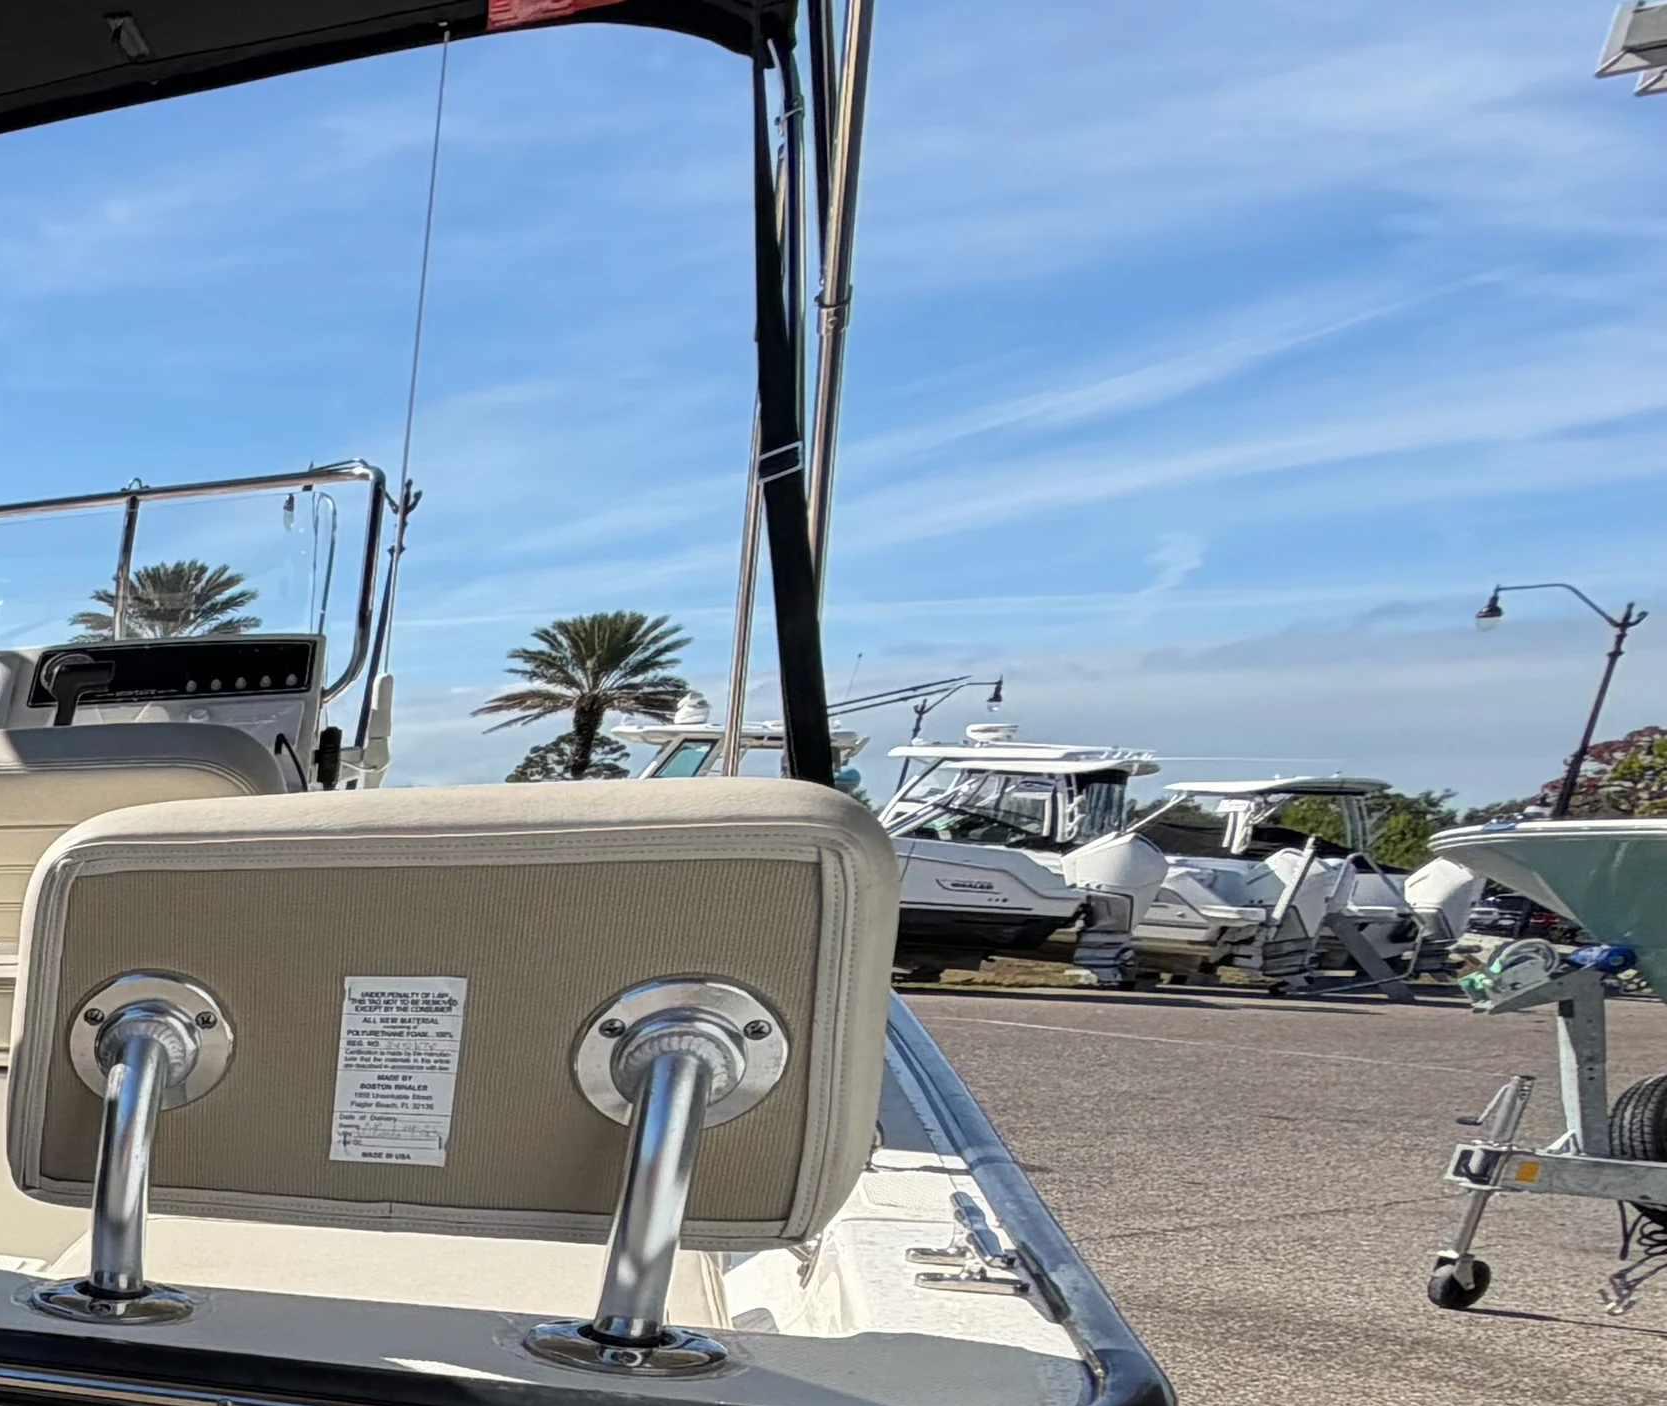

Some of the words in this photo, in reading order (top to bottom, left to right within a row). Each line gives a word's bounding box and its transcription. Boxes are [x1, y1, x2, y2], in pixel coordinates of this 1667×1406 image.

[387, 991, 419, 999] PENALTY
[362, 1017, 377, 1025] ALL
[400, 1017, 439, 1025] MATERIAL
[347, 1029, 405, 1038] POLYURETHANE
[361, 1151, 383, 1159] MADE
[395, 1152, 411, 1160] USA
